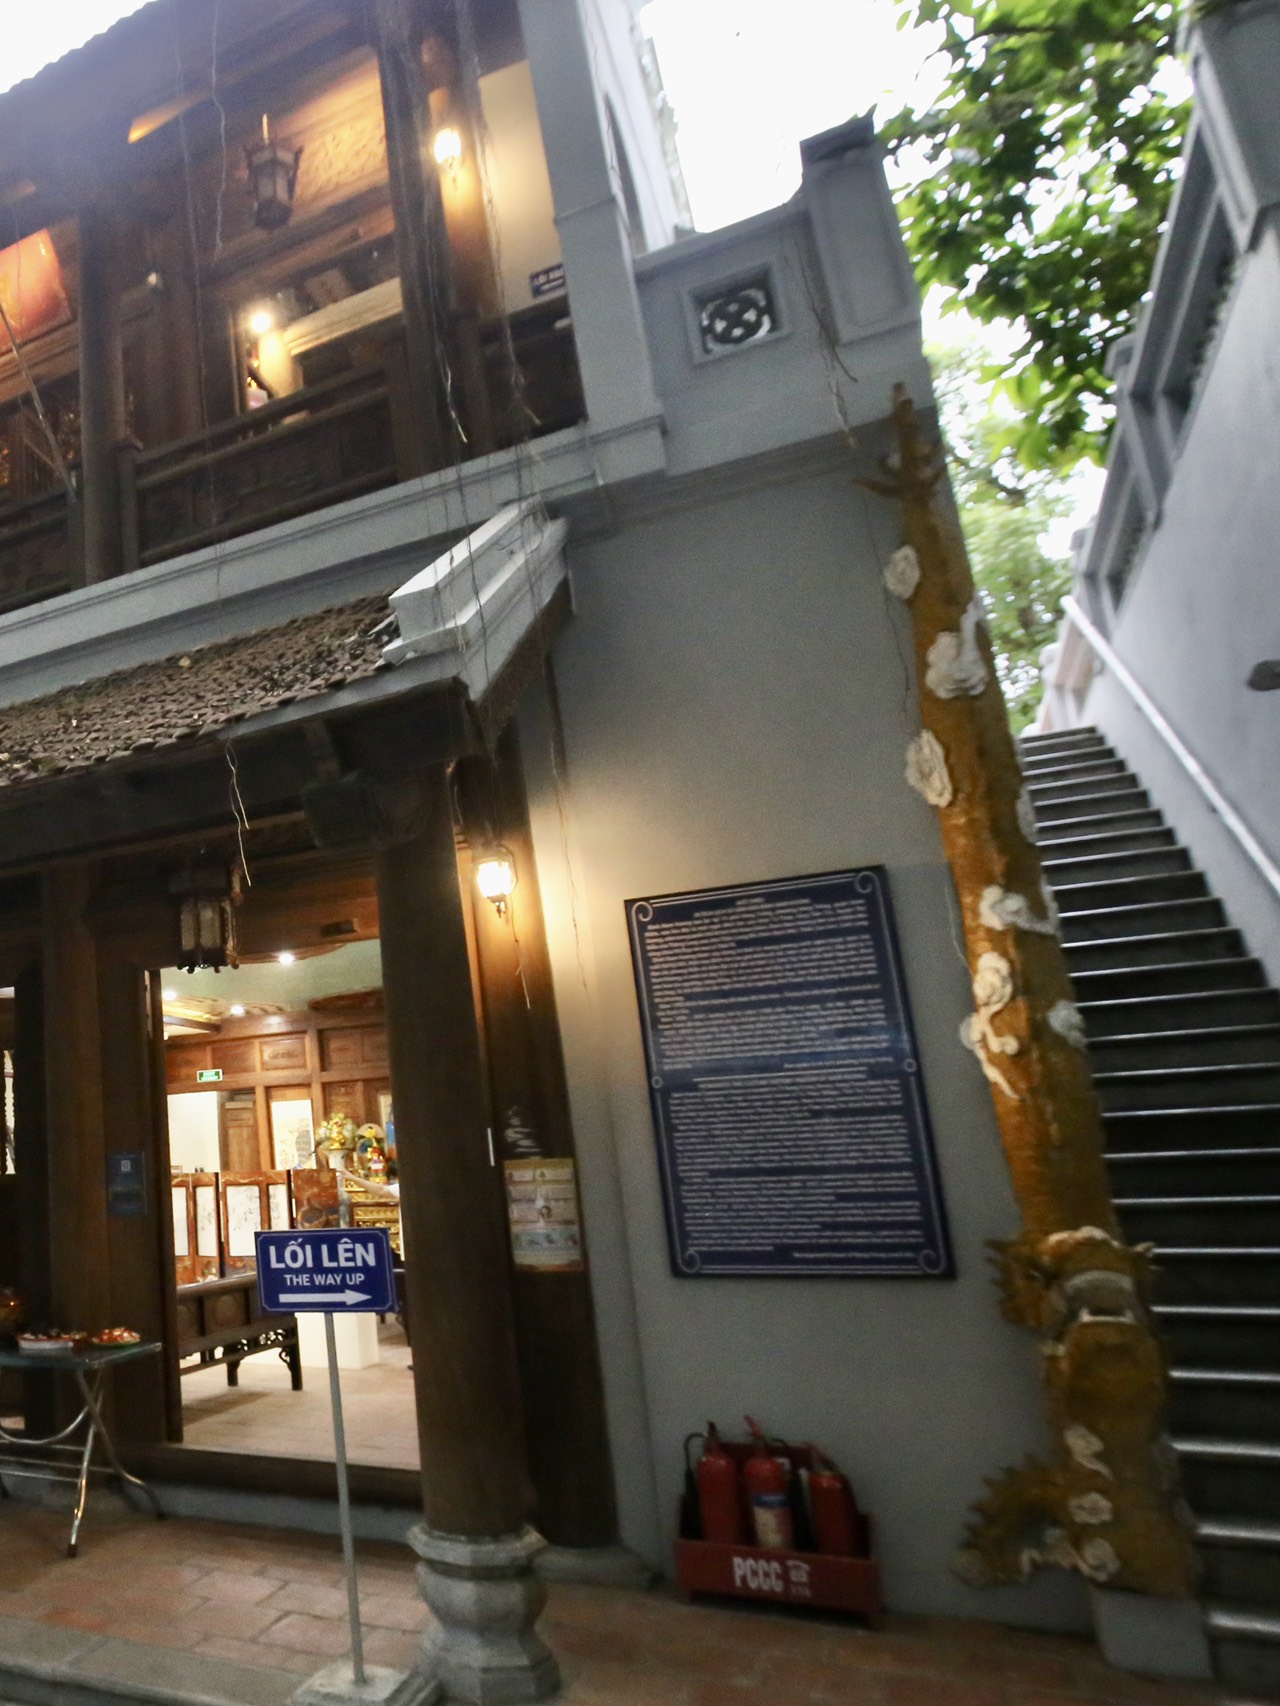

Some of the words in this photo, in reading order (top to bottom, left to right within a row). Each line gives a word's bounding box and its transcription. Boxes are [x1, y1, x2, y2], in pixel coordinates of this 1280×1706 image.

[269, 1238, 313, 1269] LỐI
[321, 1237, 376, 1268] LÊN
[284, 1274, 311, 1286] THE
[313, 1273, 344, 1286] WAY
[345, 1273, 365, 1285] UP
[732, 1556, 785, 1593] PCCC
